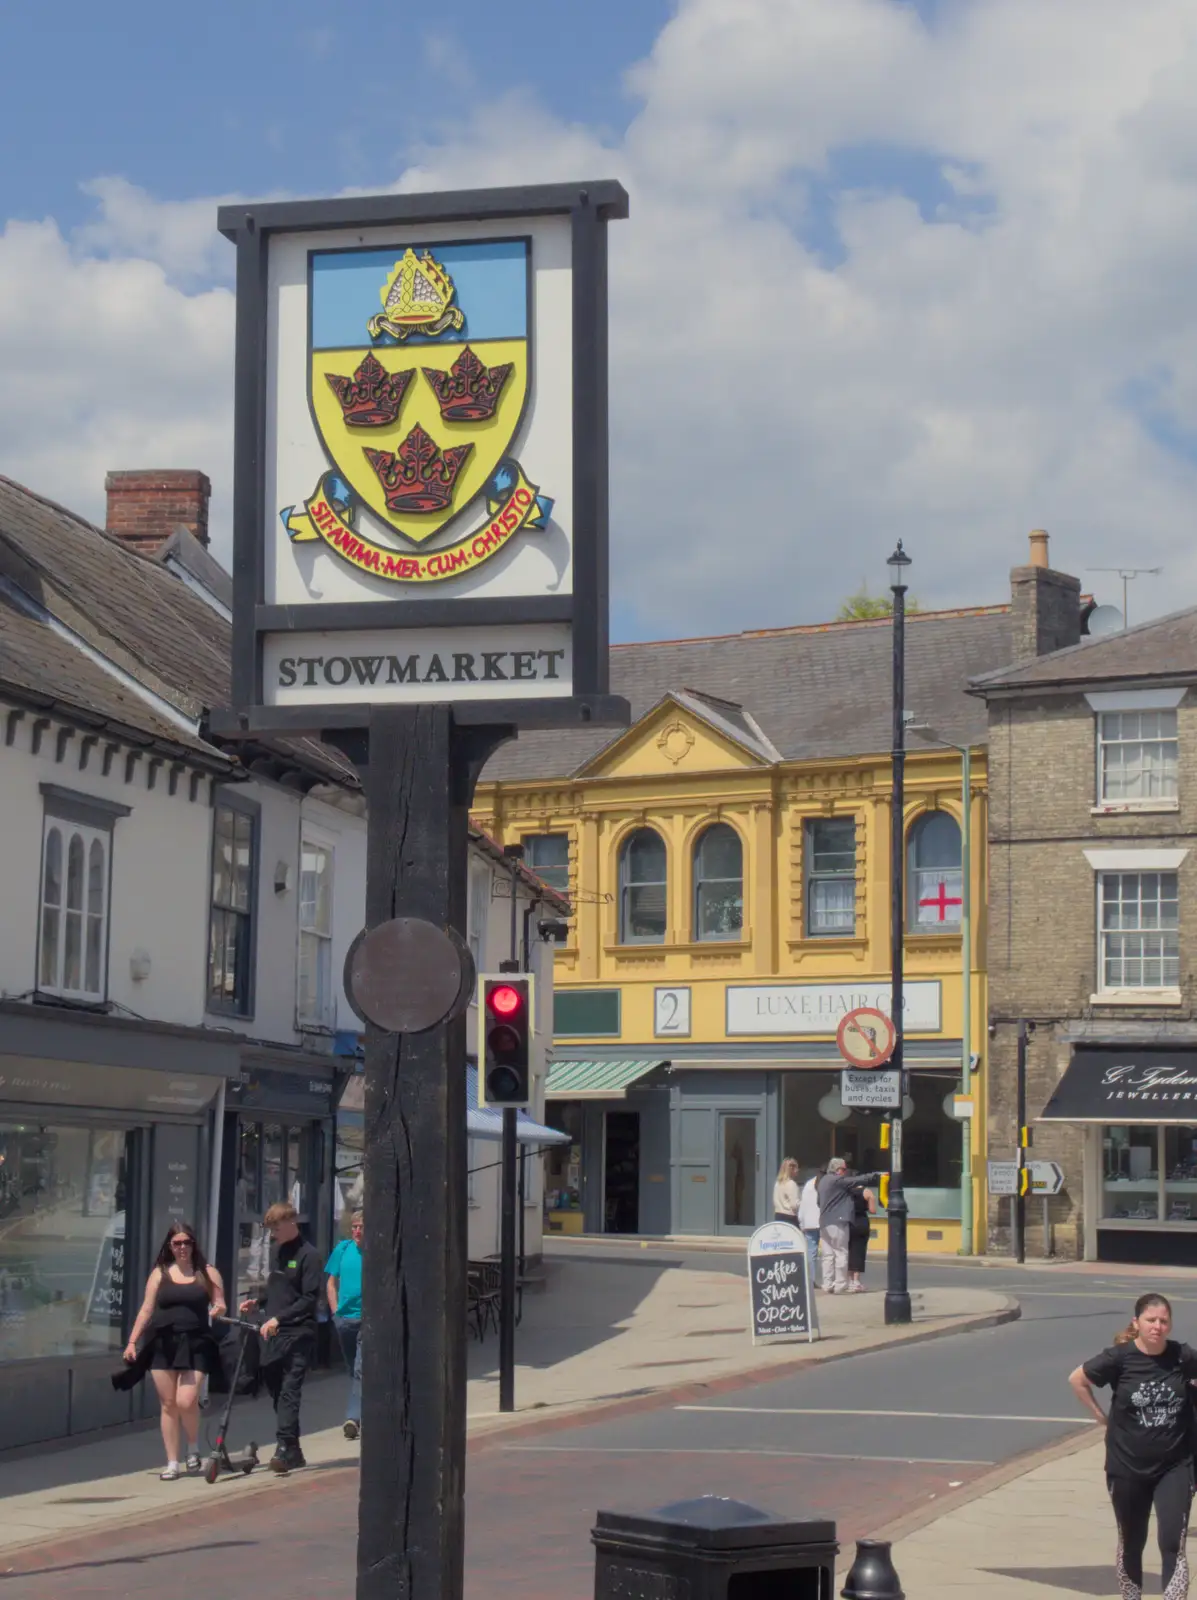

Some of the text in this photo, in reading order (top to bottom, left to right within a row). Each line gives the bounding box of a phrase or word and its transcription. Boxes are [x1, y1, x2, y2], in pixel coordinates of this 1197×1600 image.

[311, 488, 532, 578] SIT ANIMA MEA CUM CHRISTO
[278, 649, 565, 687] STOWMARKET
[660, 991, 680, 1030] 2
[756, 993, 910, 1016] LUXE HAIR C.
[848, 1074, 892, 1084] Except for
[875, 1084, 896, 1093] taxis
[848, 1094, 893, 1104] and cycles
[756, 1260, 798, 1284] Coffee
[760, 1284, 799, 1305] Shop
[756, 1304, 804, 1323] OPEN
